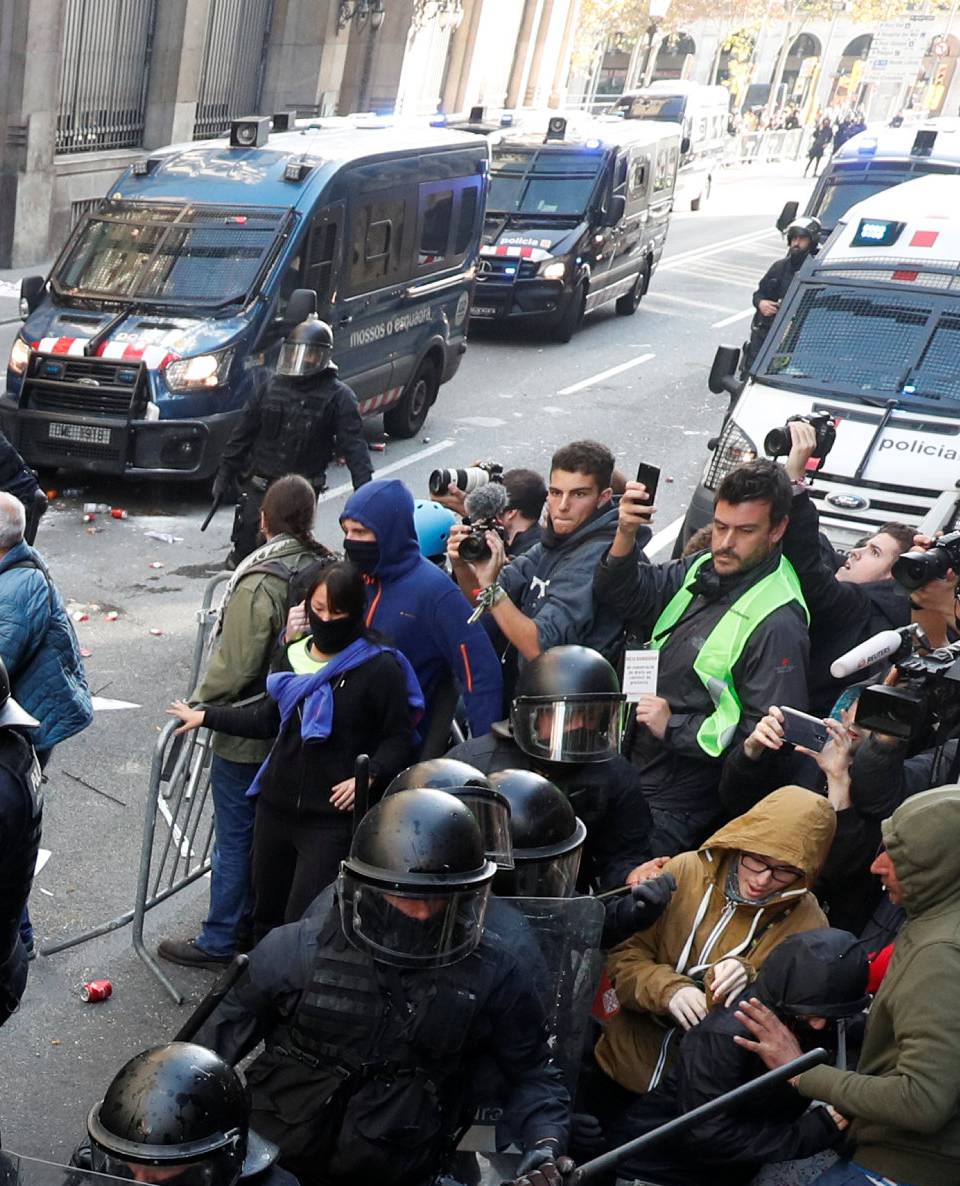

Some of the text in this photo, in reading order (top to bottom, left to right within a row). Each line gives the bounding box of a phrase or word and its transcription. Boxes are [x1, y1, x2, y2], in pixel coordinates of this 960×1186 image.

[500, 237, 539, 246] policia
[350, 323, 385, 347] mossos
[878, 439, 957, 460] policia
[867, 647, 890, 664] REUTERS
